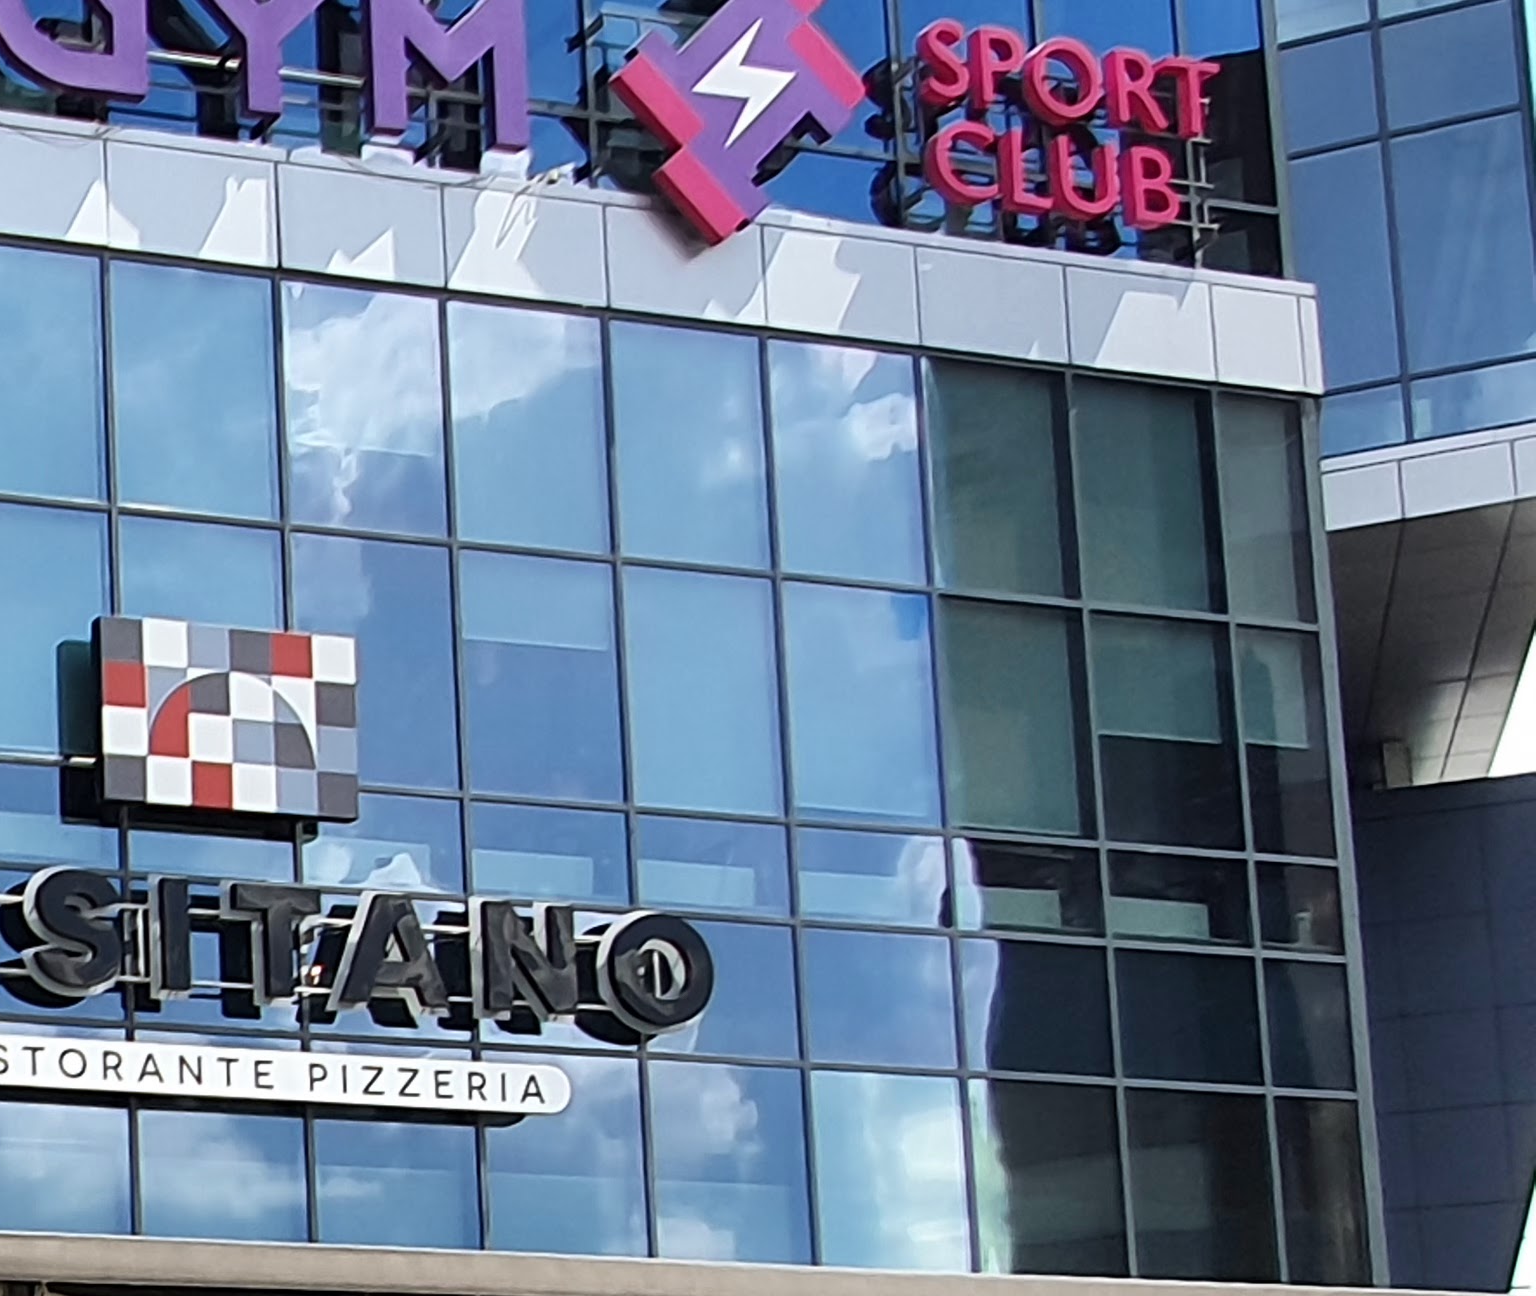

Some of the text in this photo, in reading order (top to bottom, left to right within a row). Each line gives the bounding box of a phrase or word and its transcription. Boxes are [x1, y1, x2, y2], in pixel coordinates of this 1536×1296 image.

[916, 17, 1220, 139] SPORT
[923, 120, 1182, 230] CLUB
[307, 1063, 546, 1108] PIZZERIA
